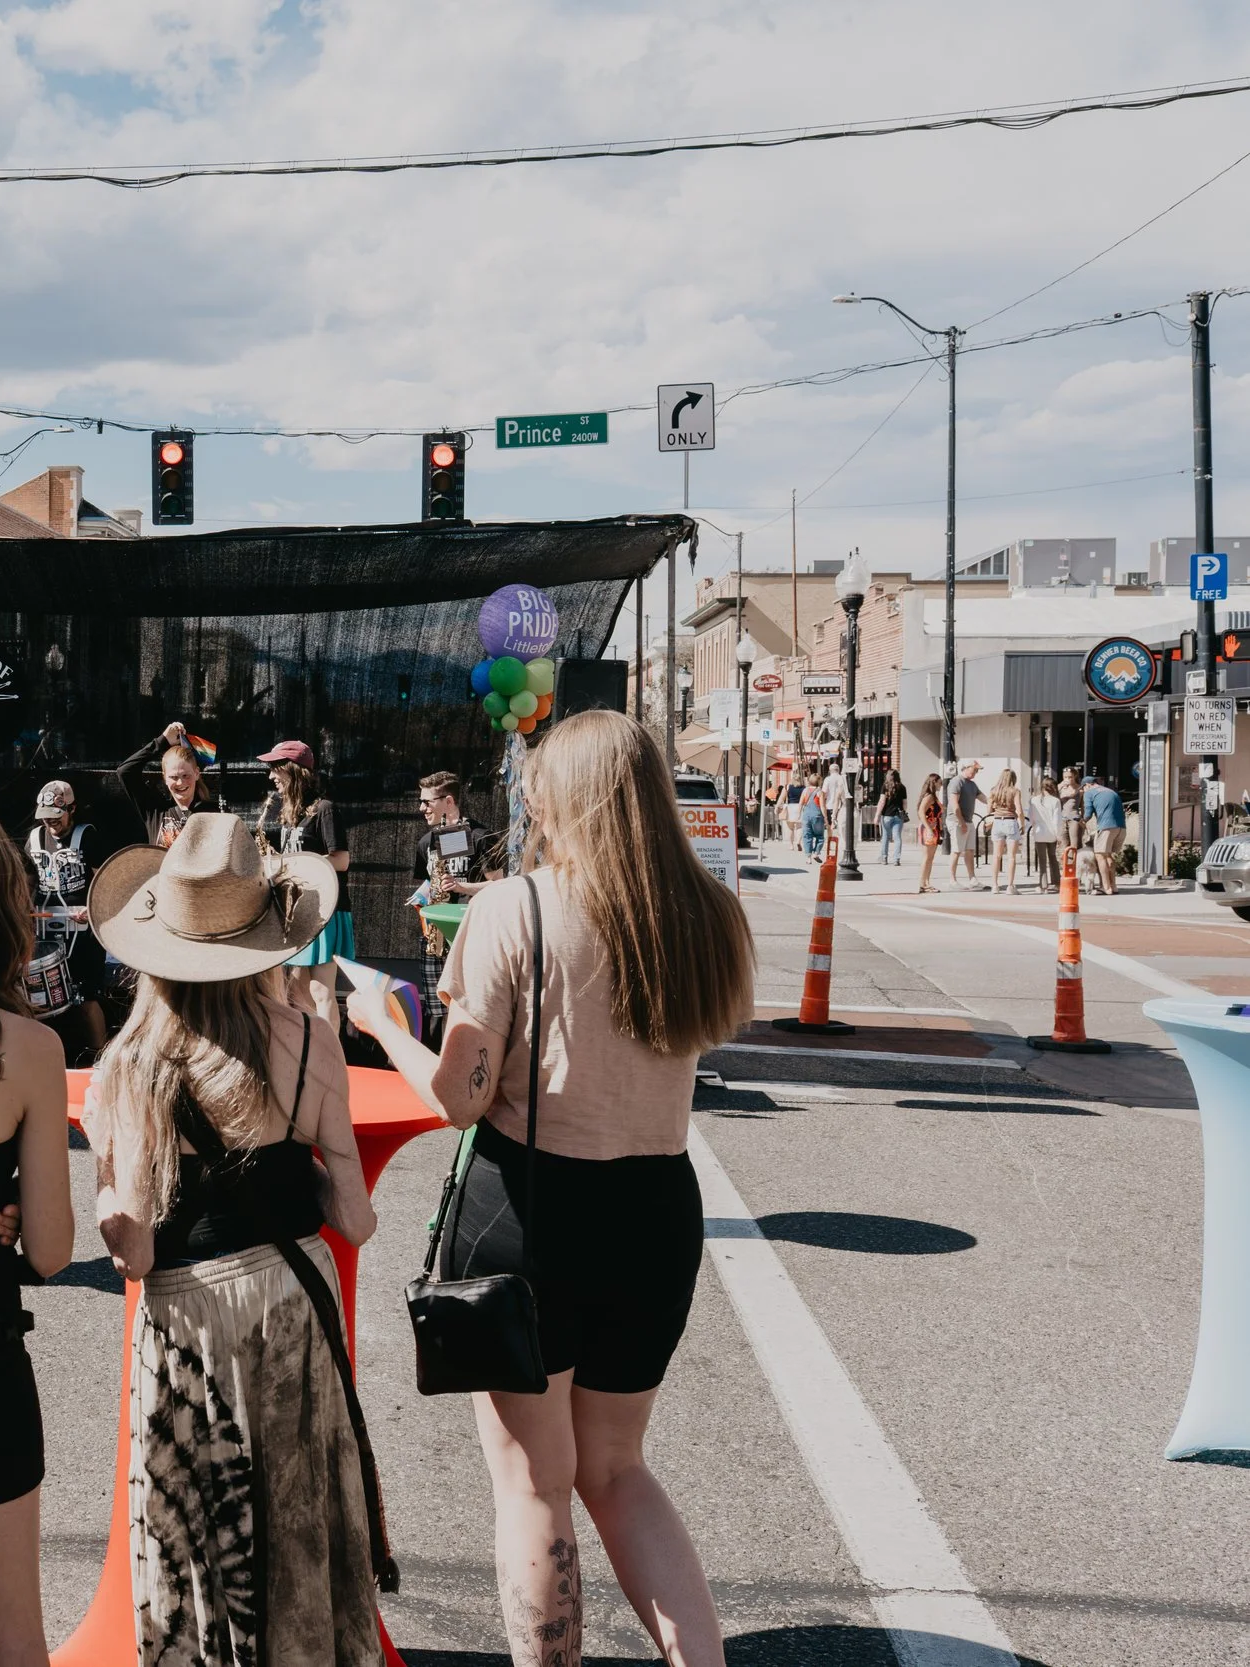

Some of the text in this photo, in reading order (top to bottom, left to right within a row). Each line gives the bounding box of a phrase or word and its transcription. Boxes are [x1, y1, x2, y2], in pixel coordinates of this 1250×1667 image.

[505, 416, 590, 445] Prince ST
[571, 432, 599, 443] 2400W
[667, 432, 707, 446] ONLY
[1195, 590, 1222, 600] FREE
[517, 590, 550, 612] BIG
[508, 611, 558, 638] PRIDE
[1094, 645, 1148, 668] DENVER BEER CO
[1189, 701, 1232, 710] NO TURNS
[1193, 712, 1226, 721] ON RED
[1198, 723, 1222, 731] WHEN
[1190, 741, 1227, 750] PRESENT
